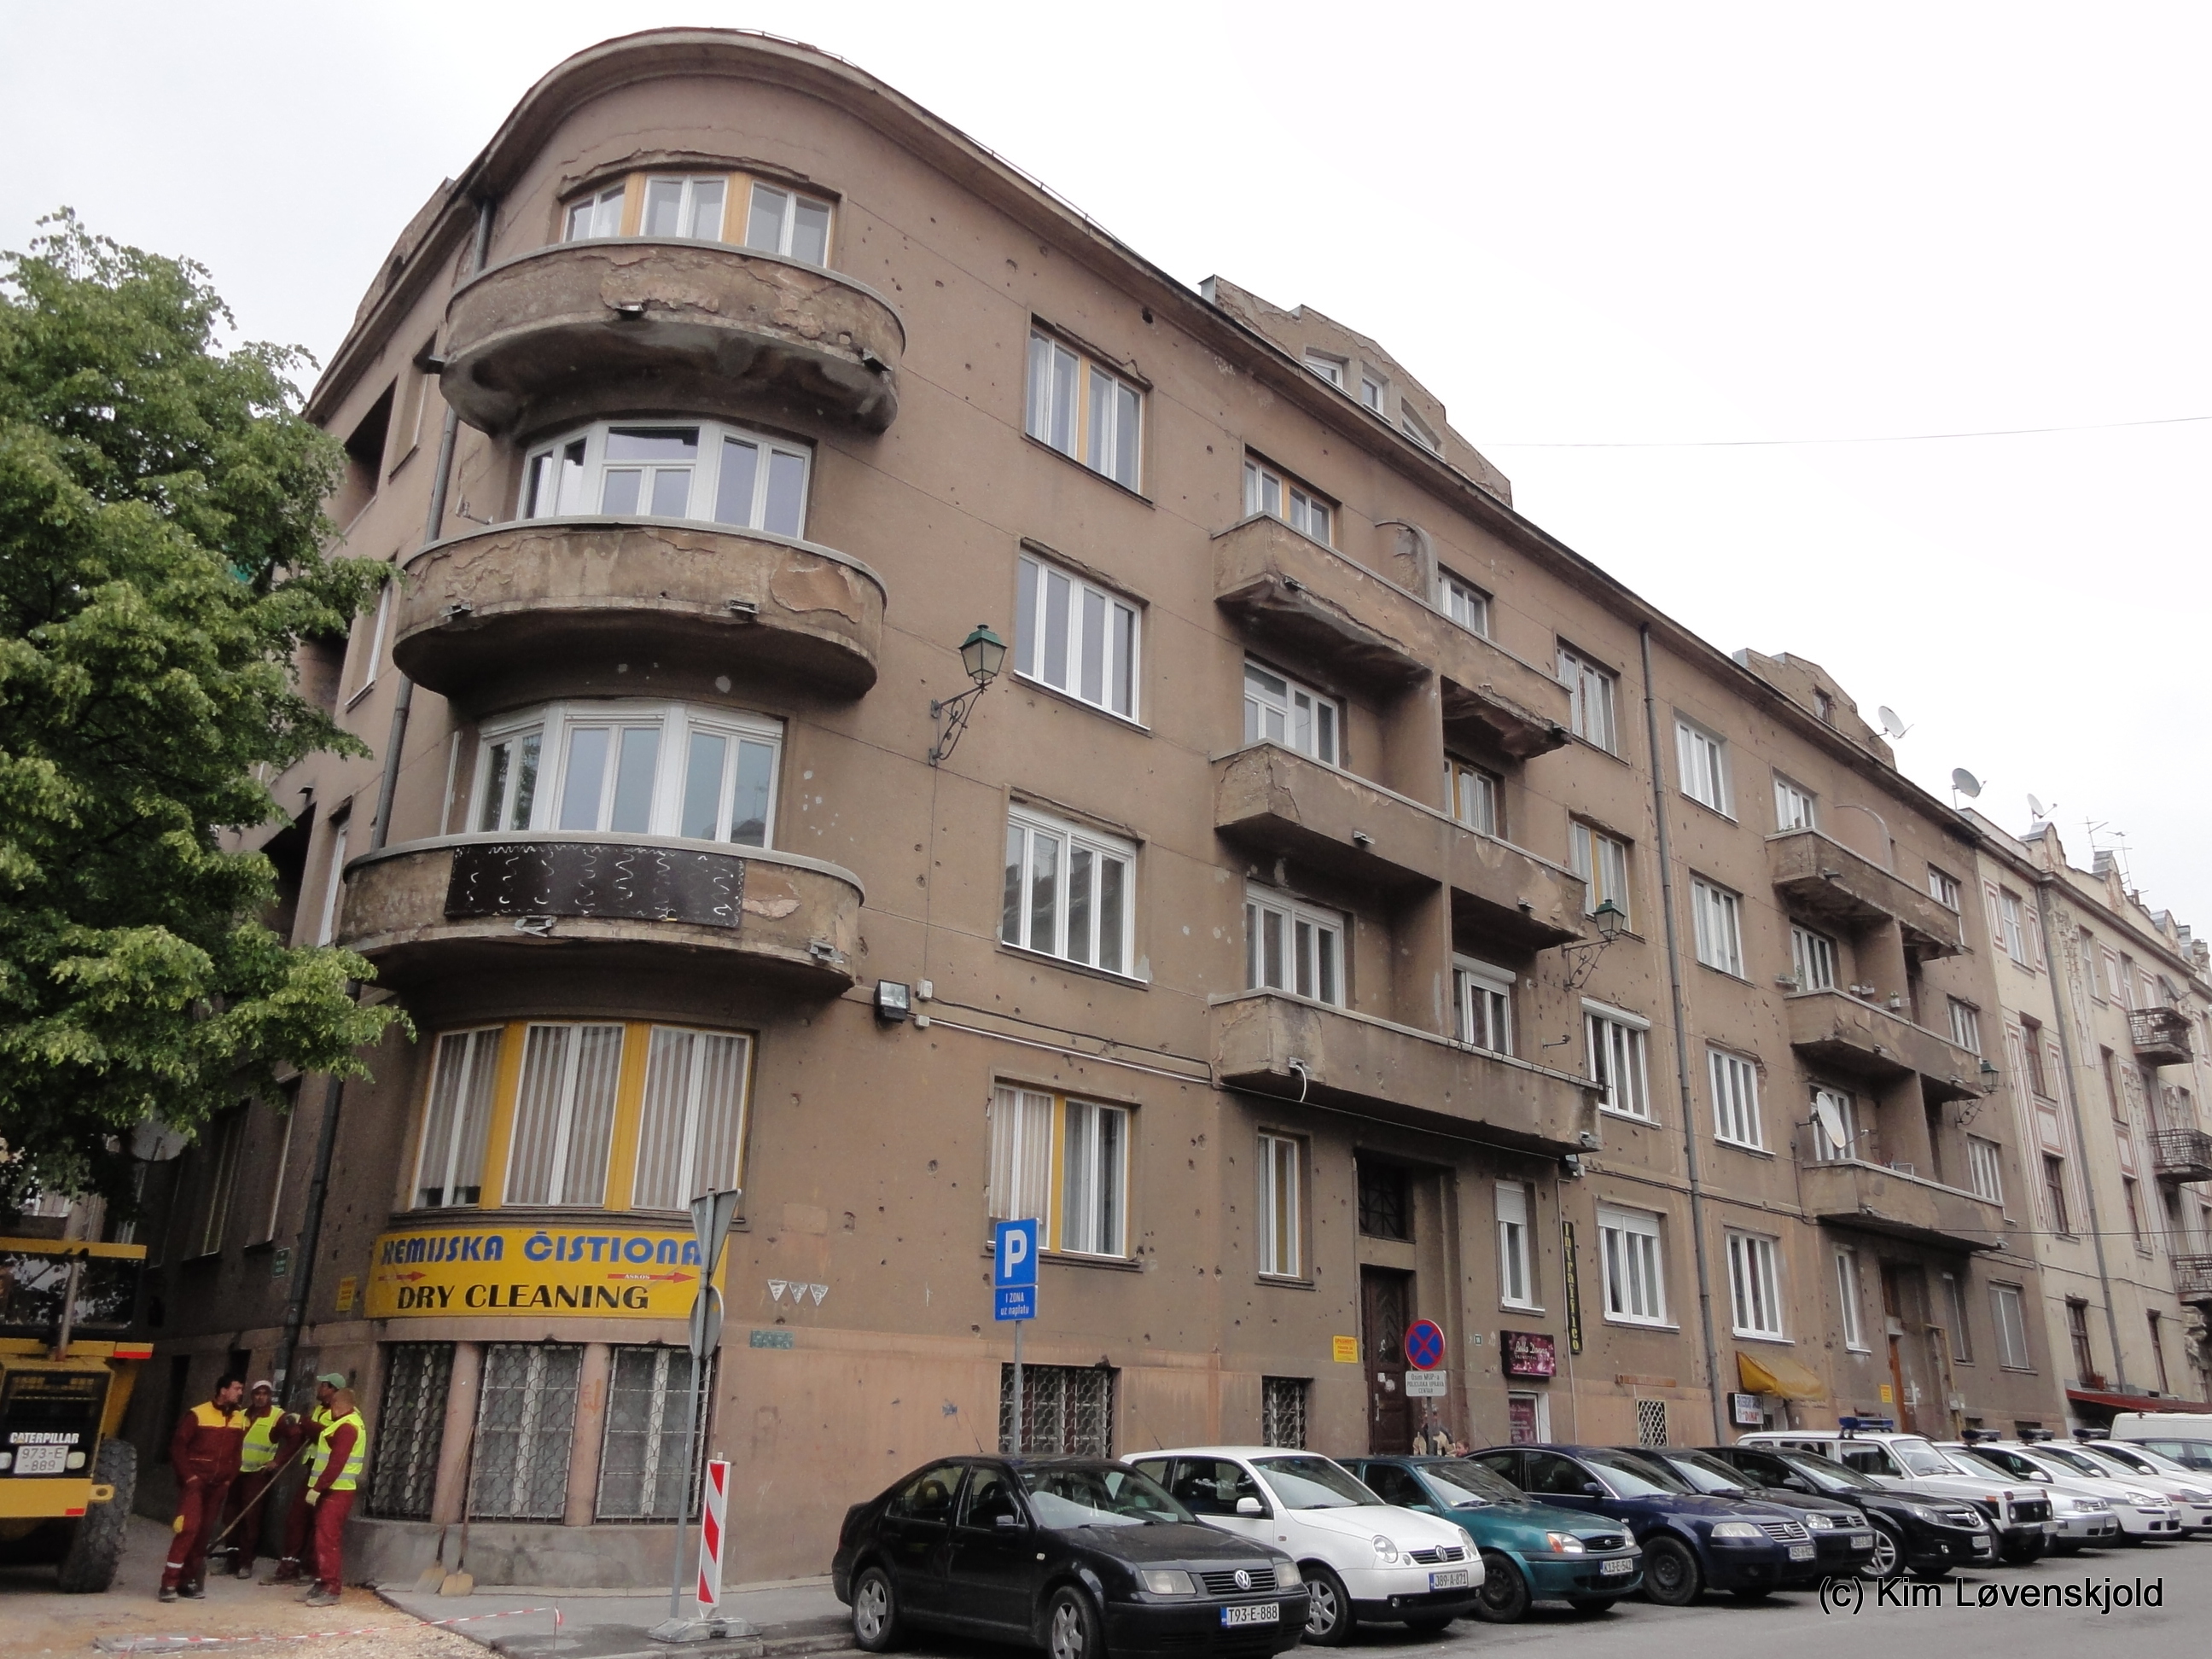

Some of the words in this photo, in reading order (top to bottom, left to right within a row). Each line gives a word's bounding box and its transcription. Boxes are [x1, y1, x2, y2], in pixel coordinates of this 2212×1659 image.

[381, 1235, 504, 1265] HEMIJSKA
[524, 1231, 702, 1266] ČISTIONA
[1004, 1229, 1027, 1278] P
[397, 1285, 455, 1310] DRY
[465, 1284, 649, 1309] CLEANING
[1010, 1292, 1025, 1303] ZONA
[1000, 1307, 1007, 1316] uz
[1008, 1305, 1030, 1318] naplatu
[9, 1432, 79, 1444] CATERPILLAR
[22, 1447, 65, 1459] 973-E
[25, 1460, 55, 1471] -889
[1435, 1572, 1467, 1587] J89-A-871
[1228, 1605, 1278, 1623] T93-E-888
